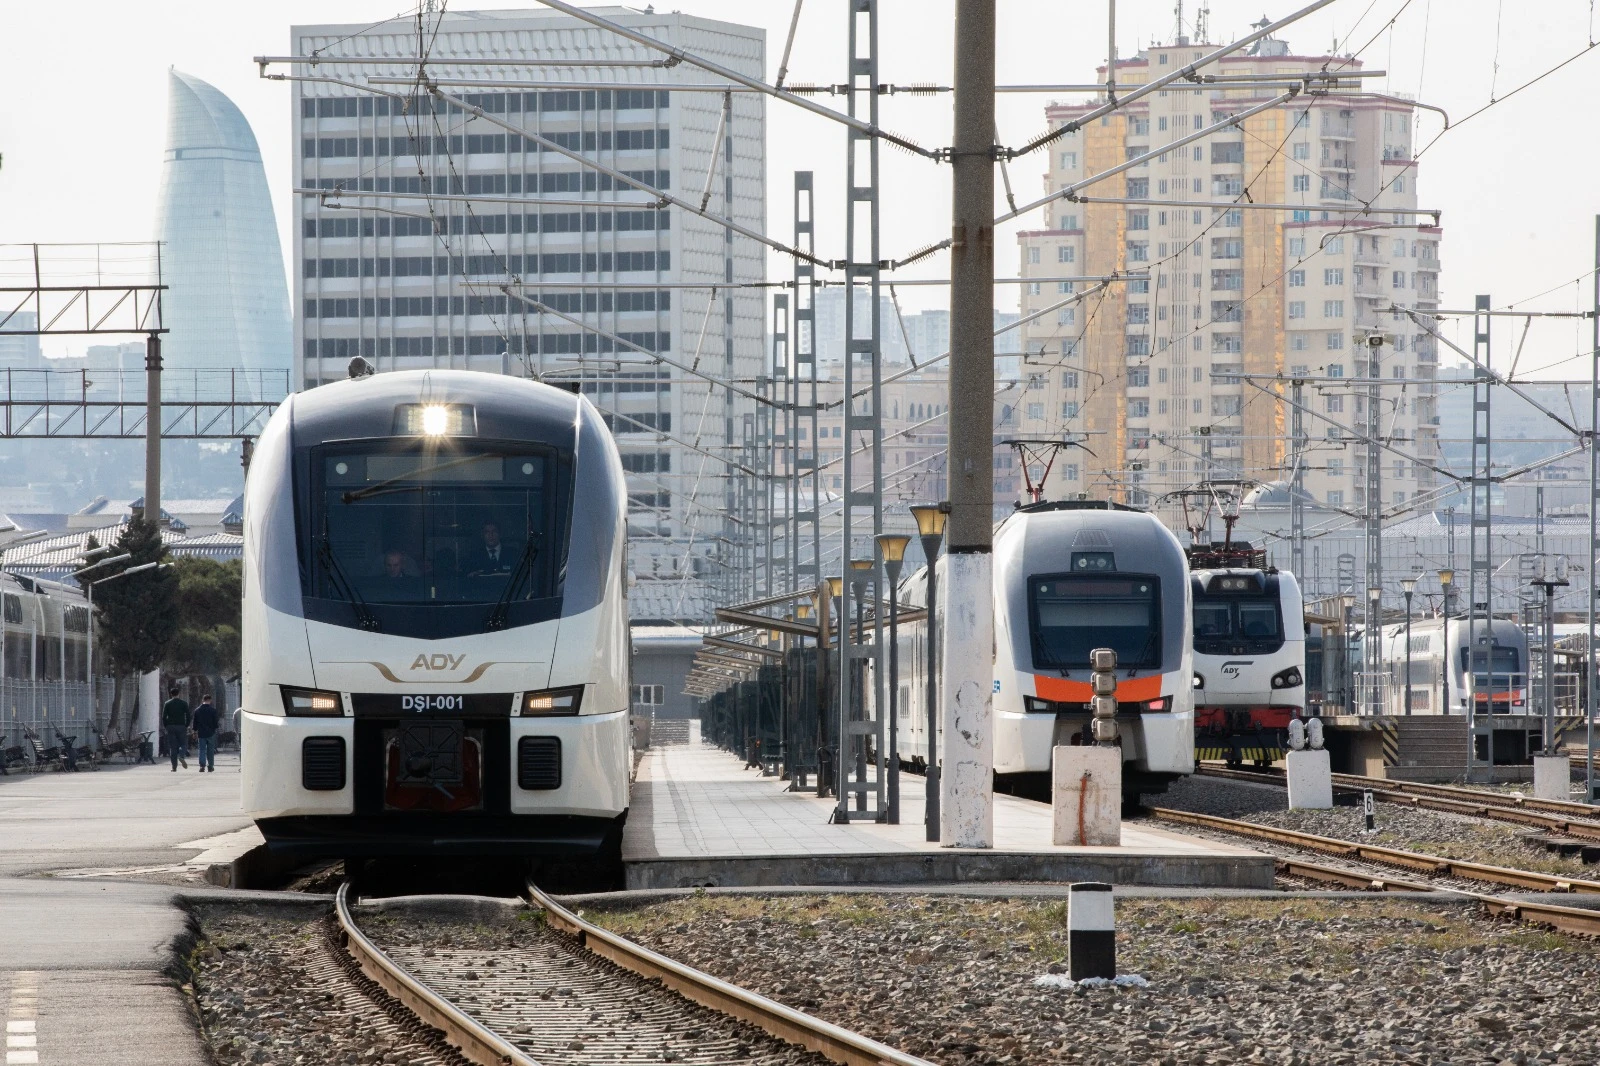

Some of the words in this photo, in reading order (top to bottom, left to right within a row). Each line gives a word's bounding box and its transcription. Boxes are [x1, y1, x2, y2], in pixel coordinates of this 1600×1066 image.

[409, 653, 467, 671] ADY
[402, 695, 463, 713] DŞI-001
[1366, 795, 1372, 812] 6
